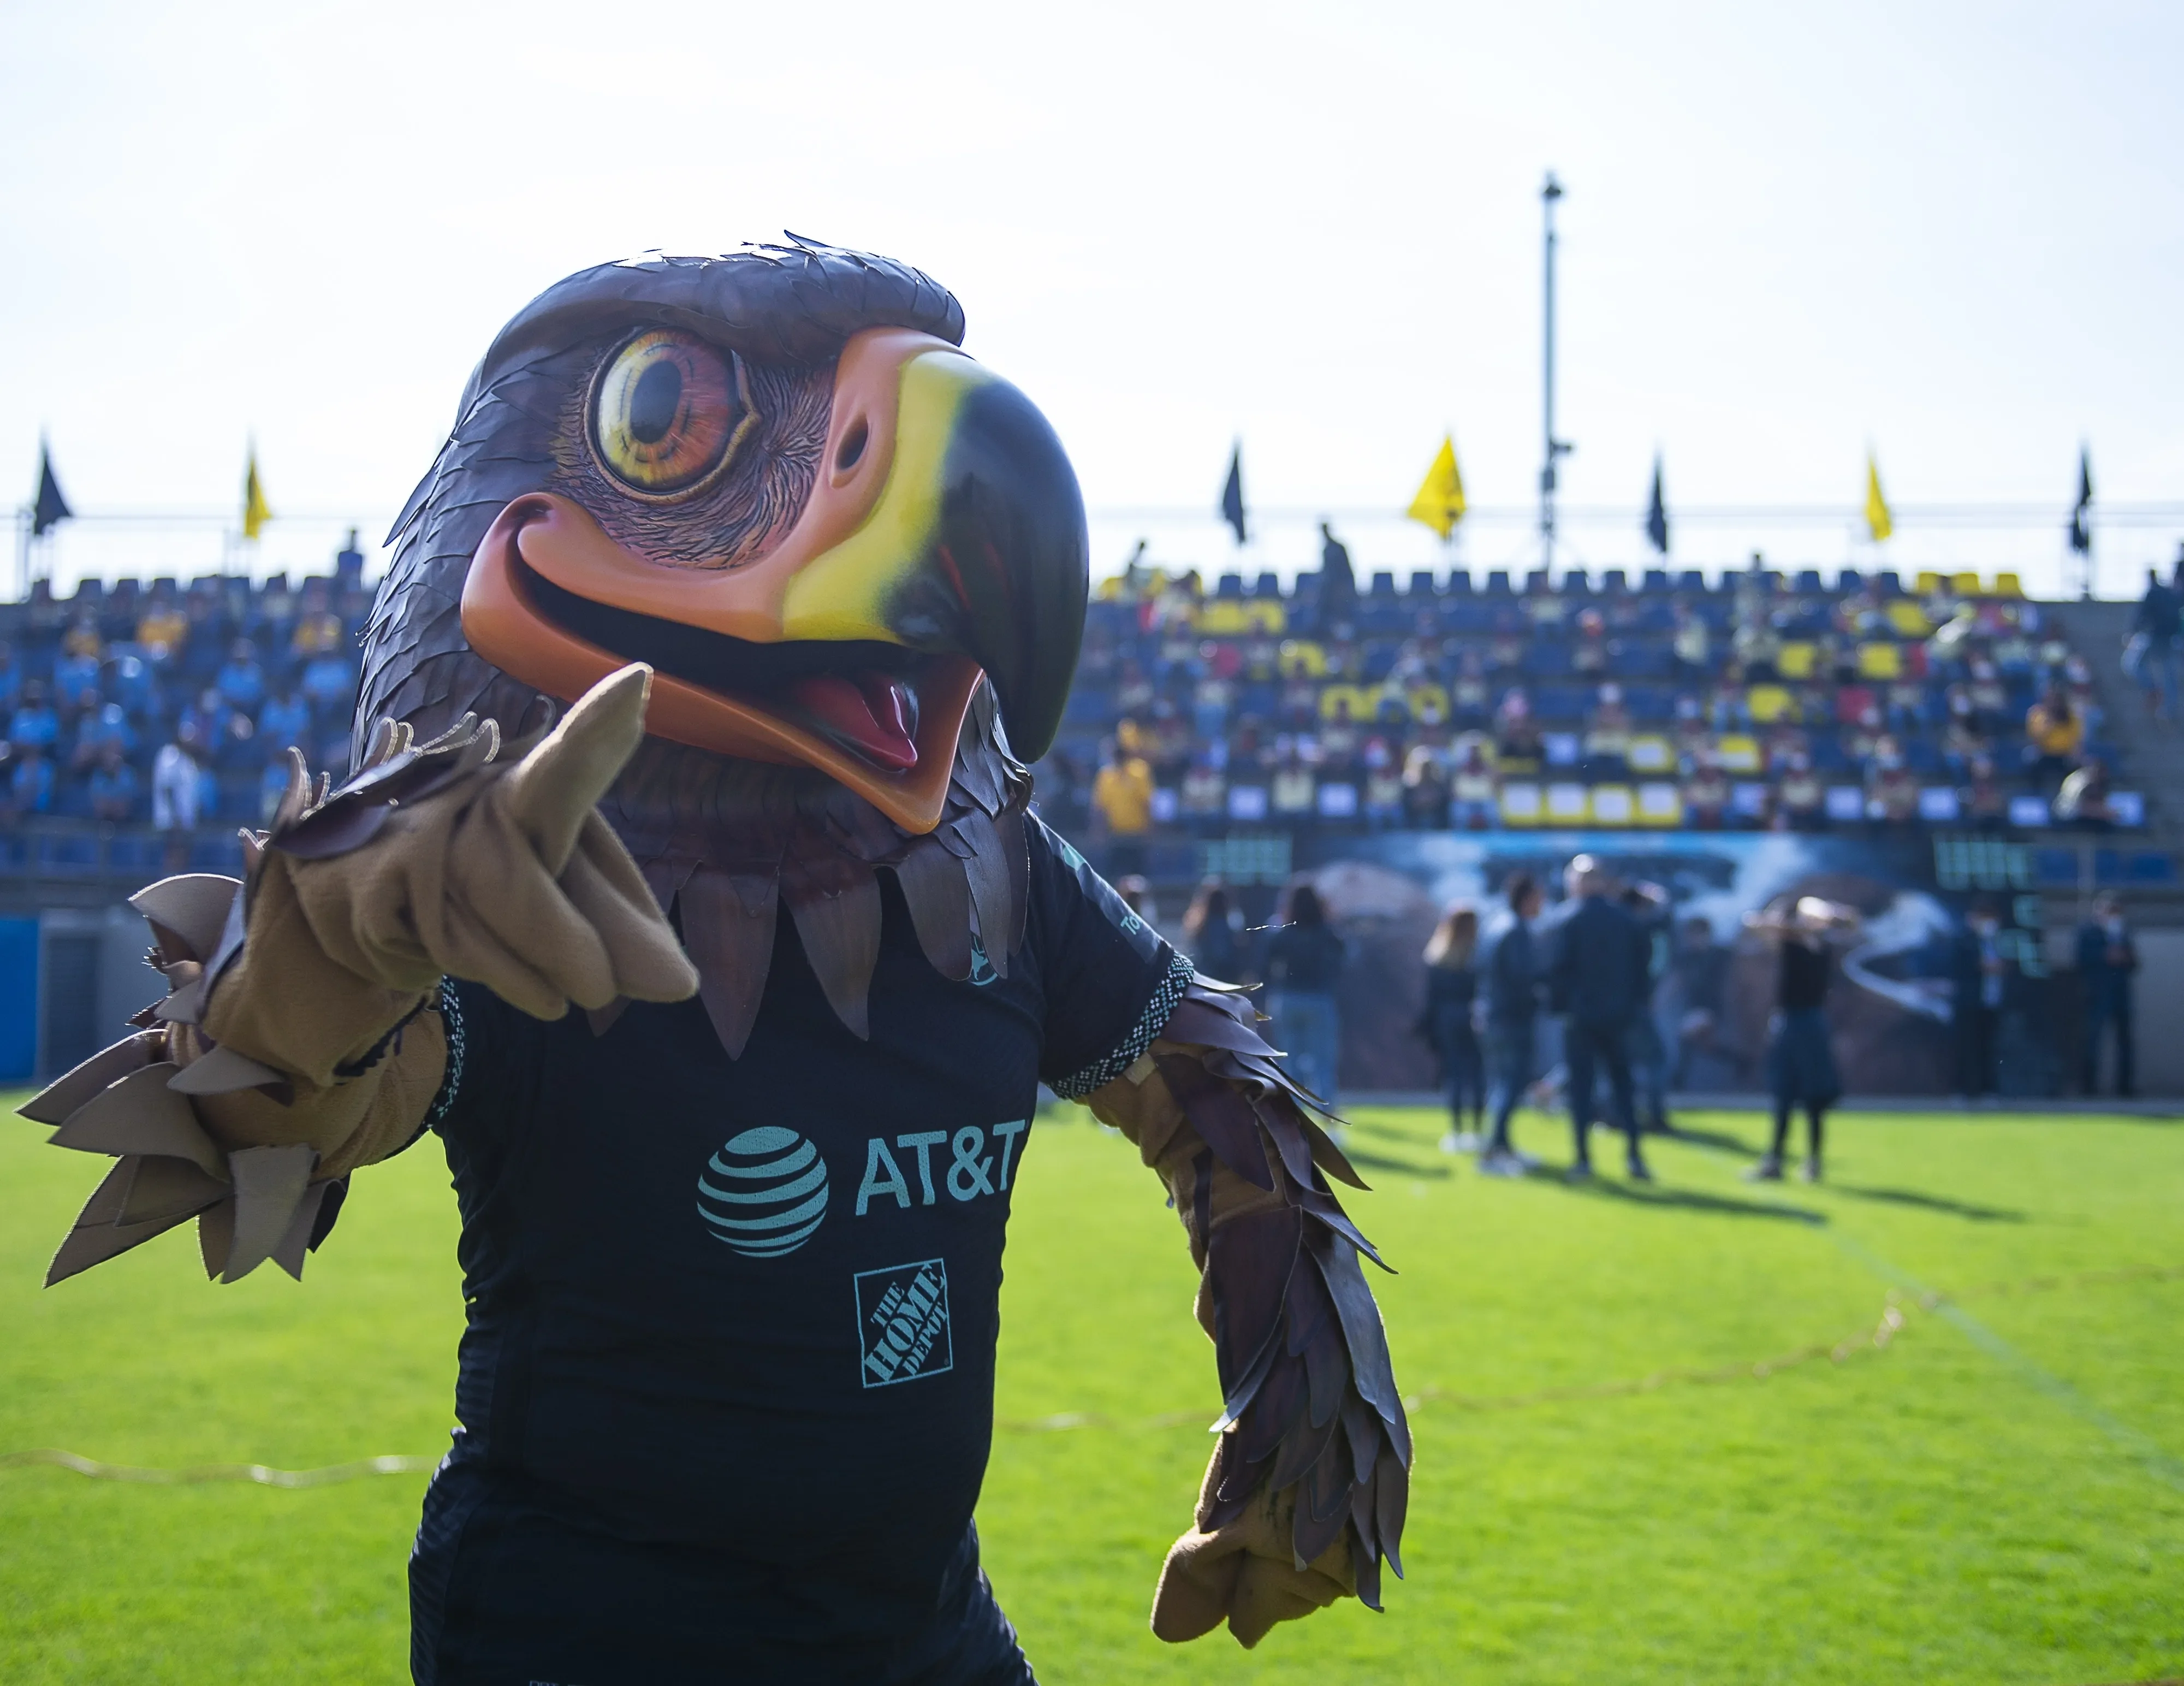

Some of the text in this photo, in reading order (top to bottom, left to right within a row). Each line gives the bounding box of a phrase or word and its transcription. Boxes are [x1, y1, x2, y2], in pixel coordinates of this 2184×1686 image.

[856, 1119, 1025, 1216] AT&T
[864, 1262, 947, 1382] HOME
[870, 1281, 904, 1328] THE
[903, 1302, 947, 1376] DEPOT
